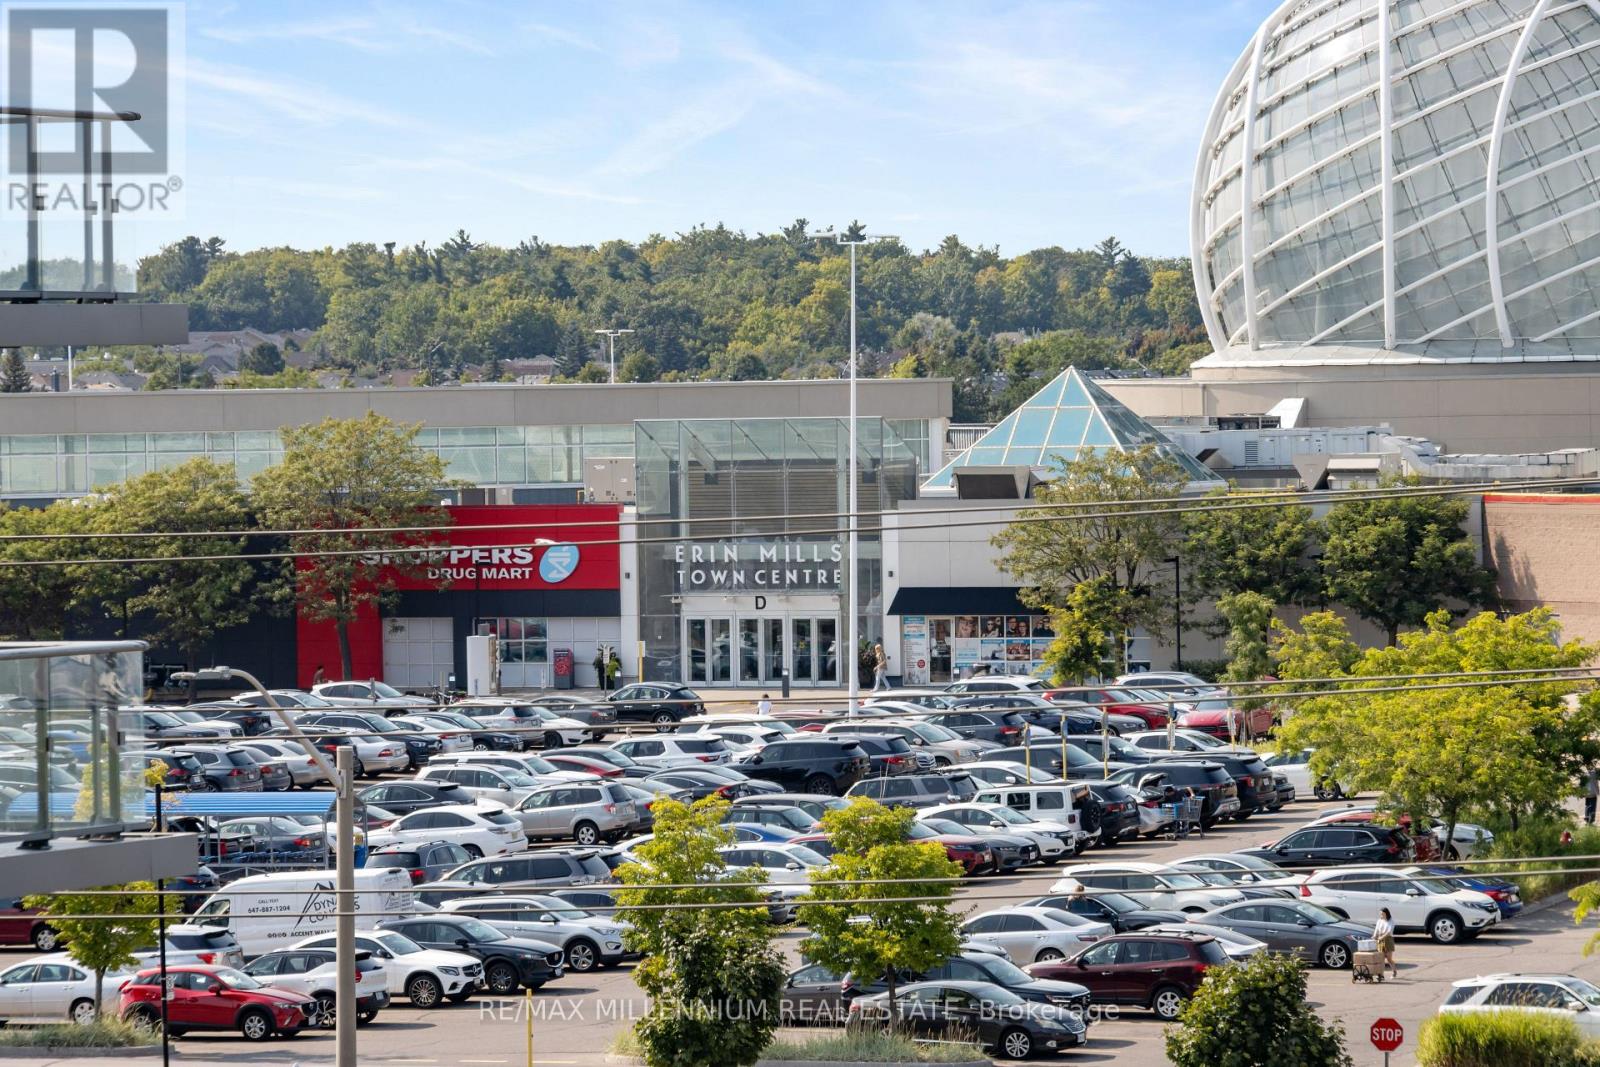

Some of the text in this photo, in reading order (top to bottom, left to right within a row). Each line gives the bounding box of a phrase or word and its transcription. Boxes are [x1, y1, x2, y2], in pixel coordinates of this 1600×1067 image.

[675, 544, 842, 563] ERIN MILLS
[427, 567, 533, 580] DRUG MART
[677, 569, 841, 585] TOWN CENTRE
[755, 595, 767, 610] D
[1372, 1027, 1402, 1042] STOP
